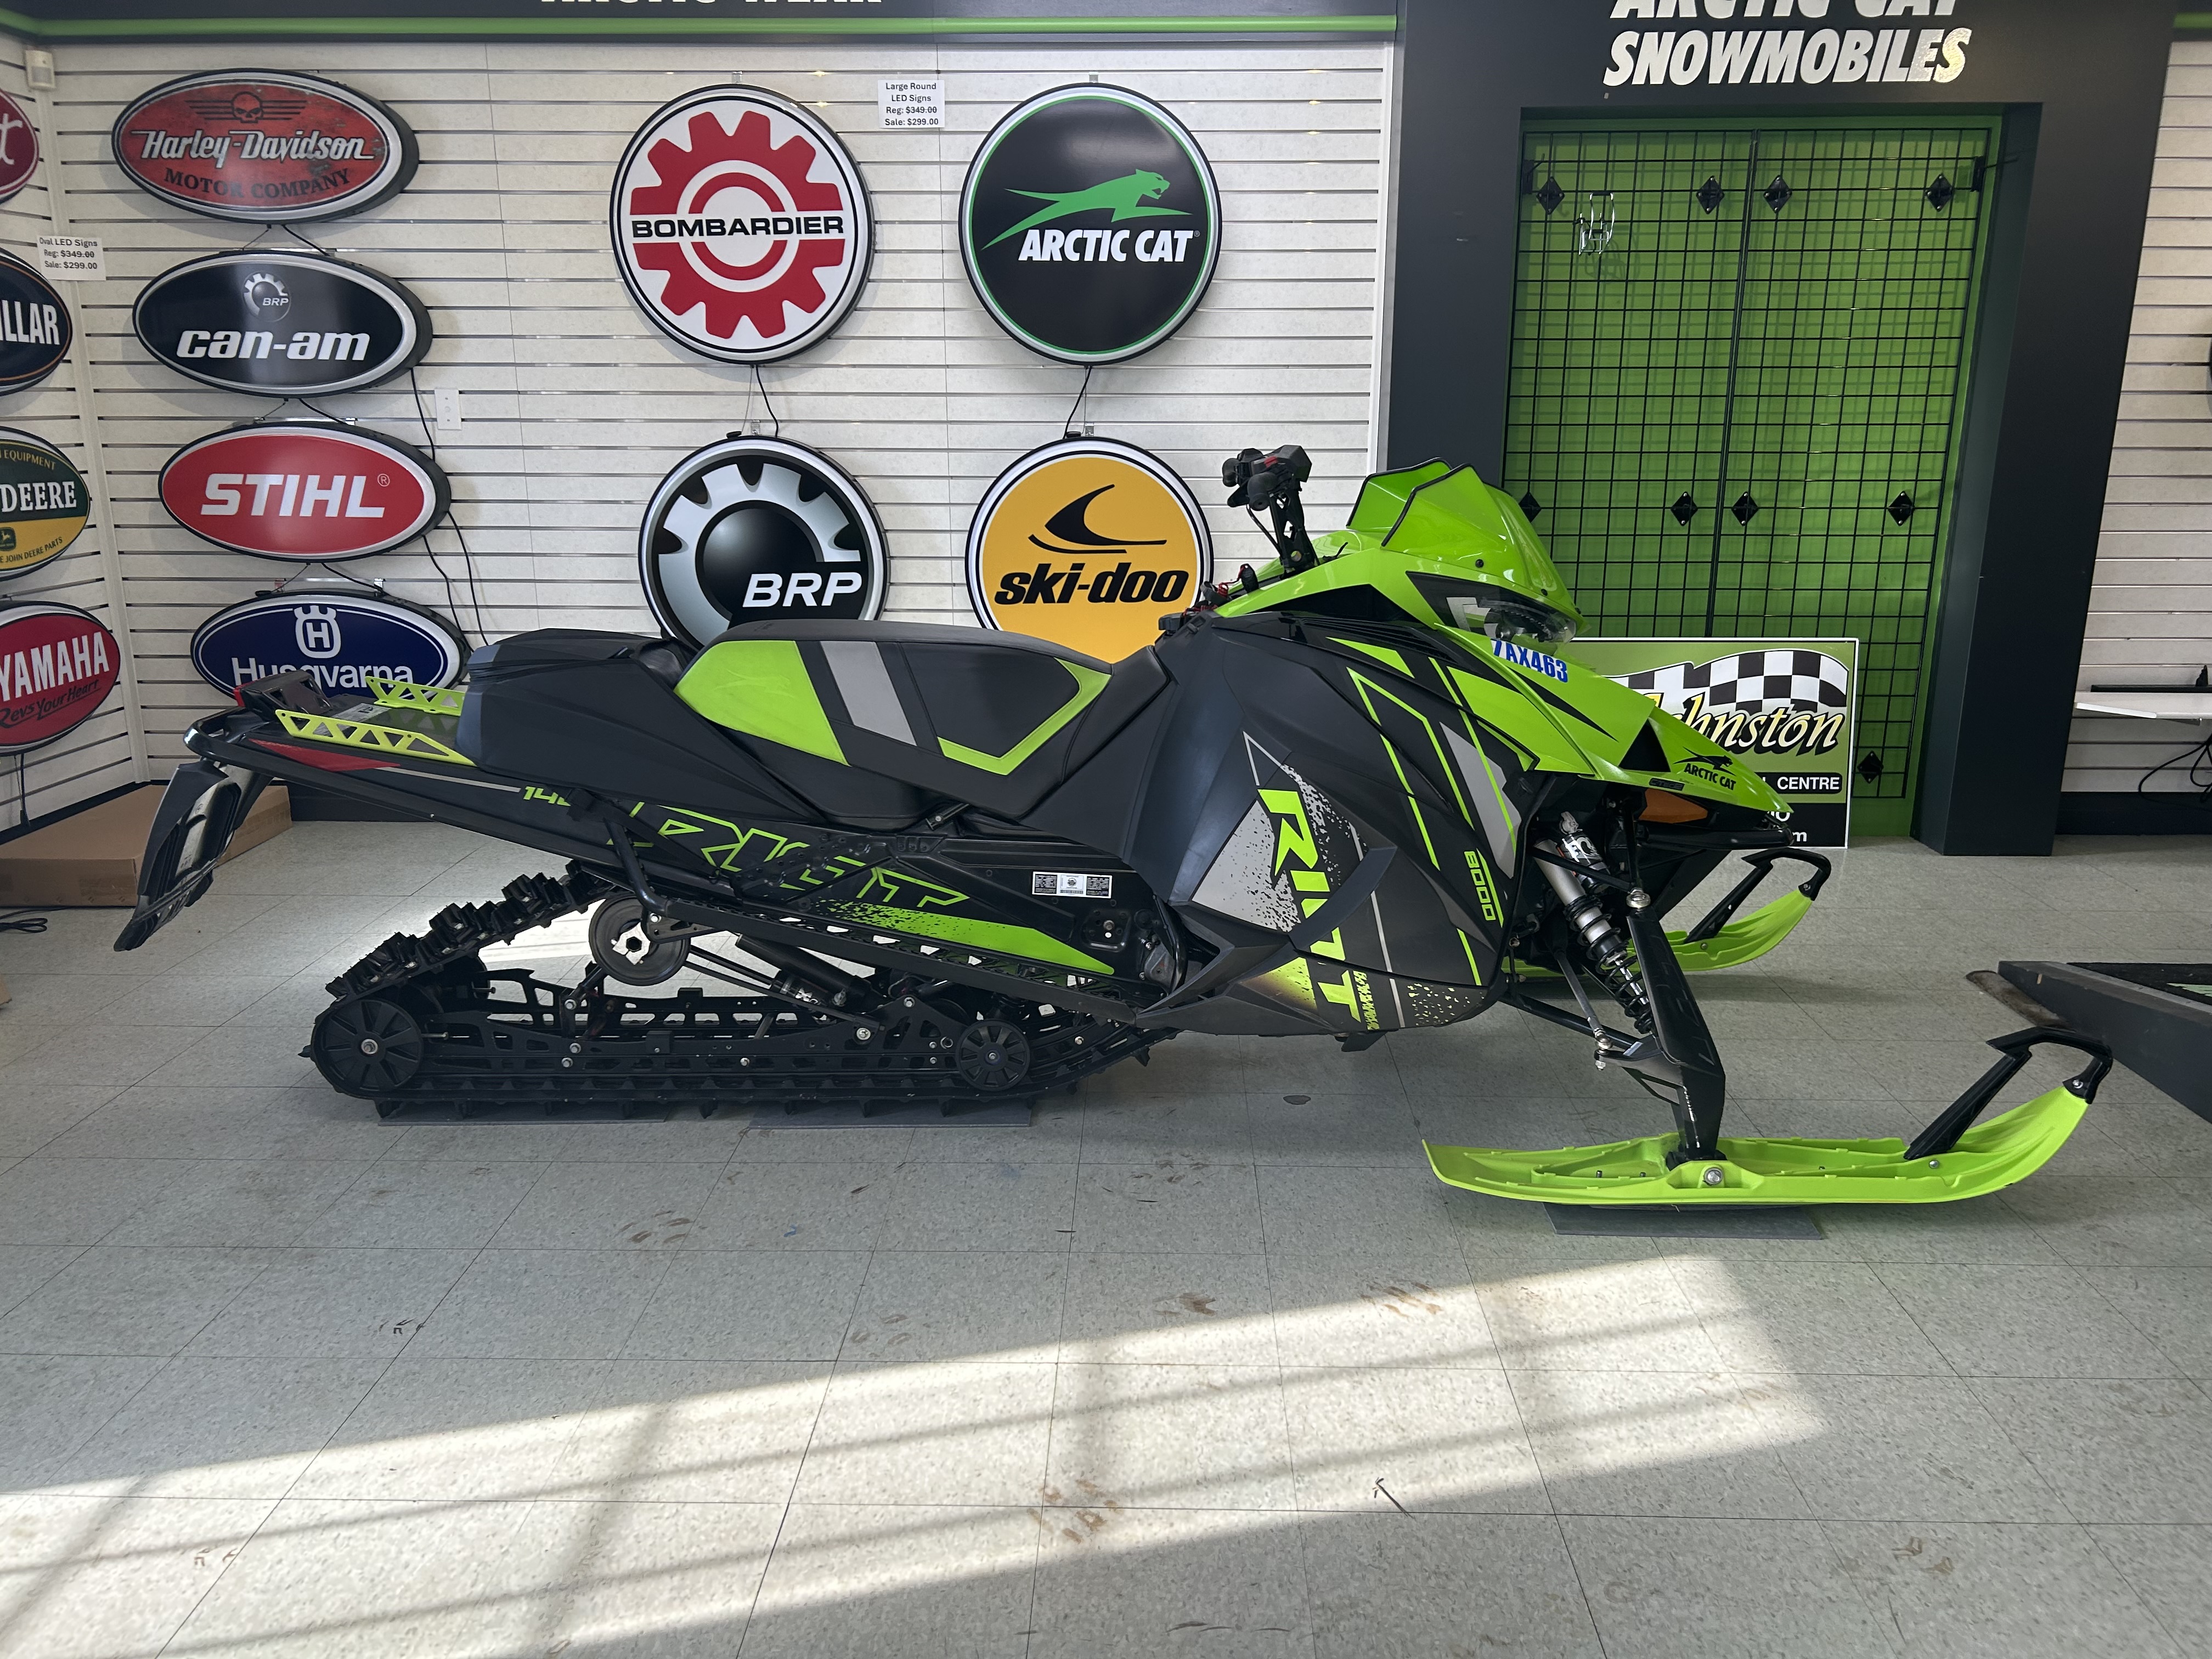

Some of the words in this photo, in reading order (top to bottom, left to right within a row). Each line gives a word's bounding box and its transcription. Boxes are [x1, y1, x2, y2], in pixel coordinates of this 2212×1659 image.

[1602, 27, 1972, 86] SNOWMOBILES
[885, 83, 908, 91] Large
[909, 94, 931, 103] Signs
[886, 106, 904, 115] Reg:
[906, 106, 937, 114] $349.00
[907, 118, 939, 126] $299.00
[131, 130, 375, 168] Harley-Davidson
[165, 167, 244, 198] MOTOR
[251, 168, 351, 199] COMPANY
[632, 216, 843, 238] BOMBARDIER
[44, 249, 59, 258] Reg:
[60, 250, 94, 258] $349.00
[75, 239, 98, 248] Signs
[1018, 229, 1130, 262] ARCTIC
[262, 297, 289, 306] BRP
[0, 300, 60, 345] LLAR
[177, 330, 370, 360] can-am
[4, 449, 56, 471] EQUIPMENT
[0, 481, 77, 513] DEERE
[5, 552, 23, 563] JOHN
[24, 546, 44, 559] DEERE
[44, 537, 63, 552] PARTS
[742, 571, 862, 608] BRP
[995, 562, 1189, 605] ski-doo
[0, 631, 110, 702] YAMAHA
[36, 695, 67, 720] Your
[66, 679, 99, 702] Heart
[1684, 763, 1718, 784] ARCTIC
[1719, 776, 1736, 791] CAT
[1777, 776, 1840, 790] CENTRE
[1464, 850, 1497, 922] 8000
